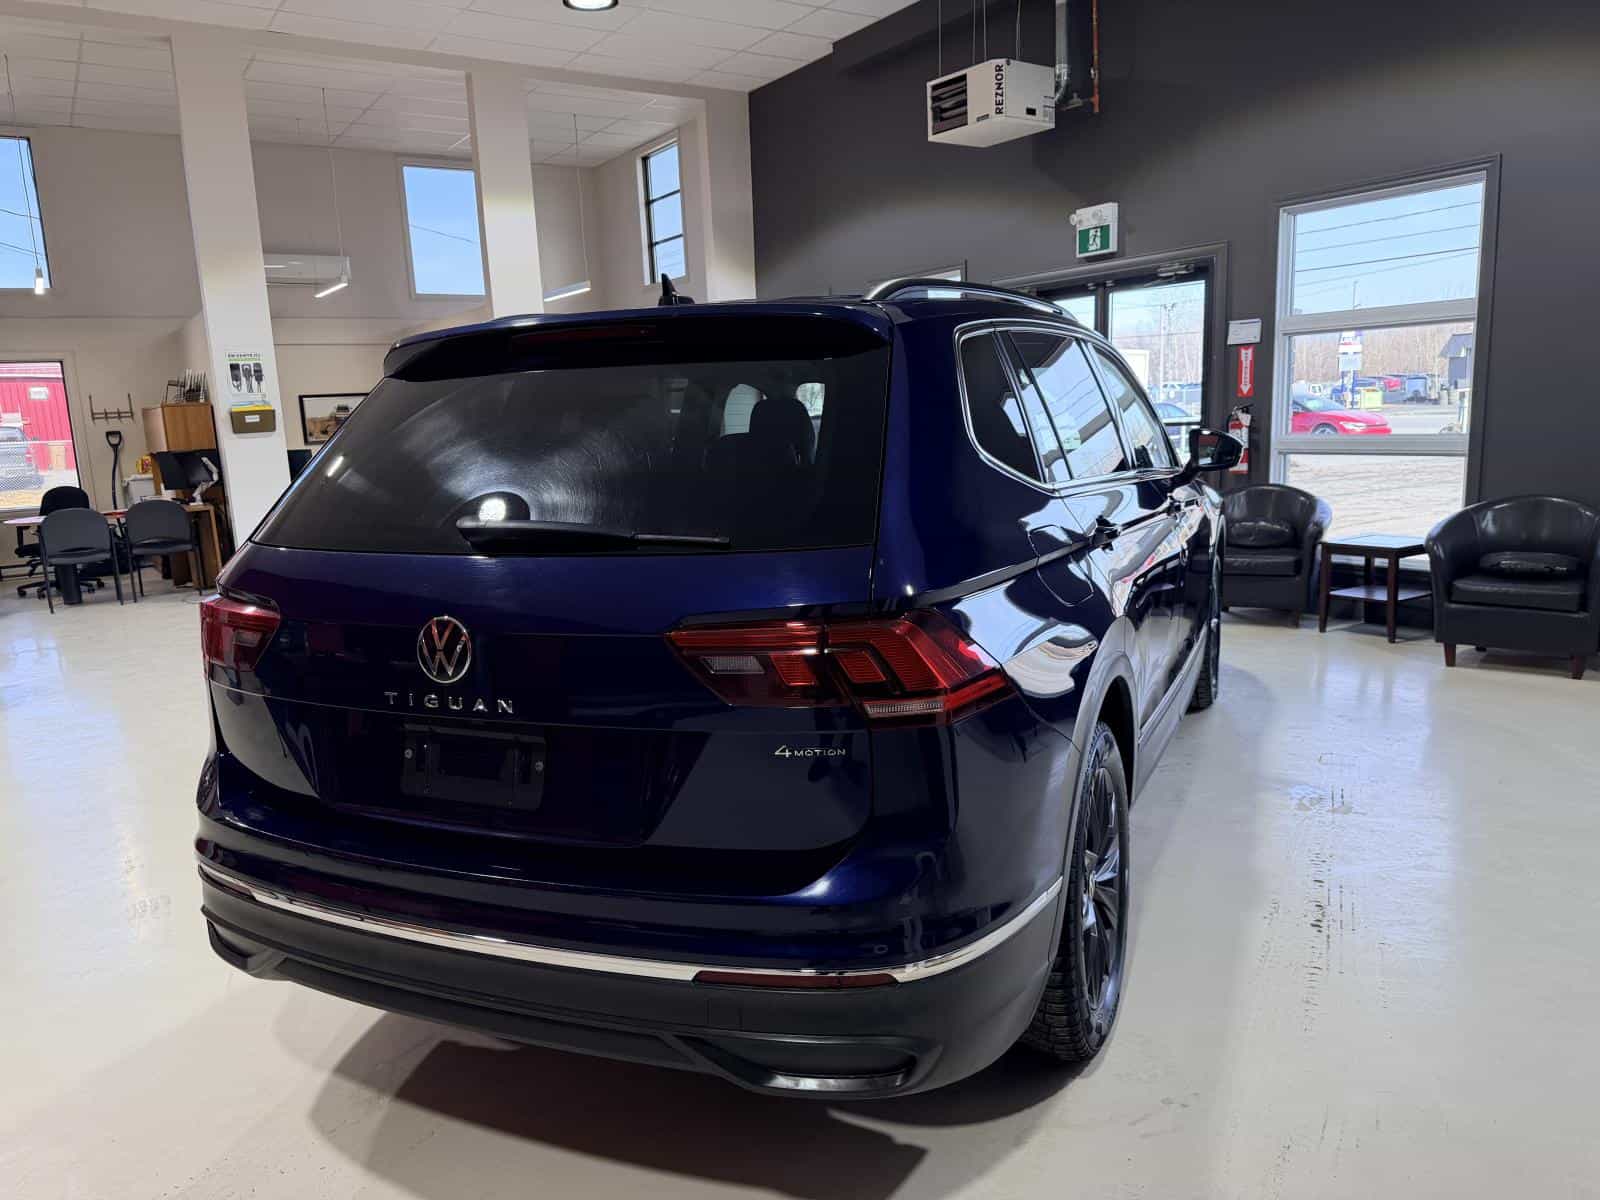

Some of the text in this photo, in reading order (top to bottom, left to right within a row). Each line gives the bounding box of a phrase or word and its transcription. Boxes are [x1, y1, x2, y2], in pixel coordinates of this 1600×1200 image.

[994, 63, 1004, 115] REZNOR
[383, 691, 514, 714] TIGUAN
[774, 745, 846, 758] 4MOTION
